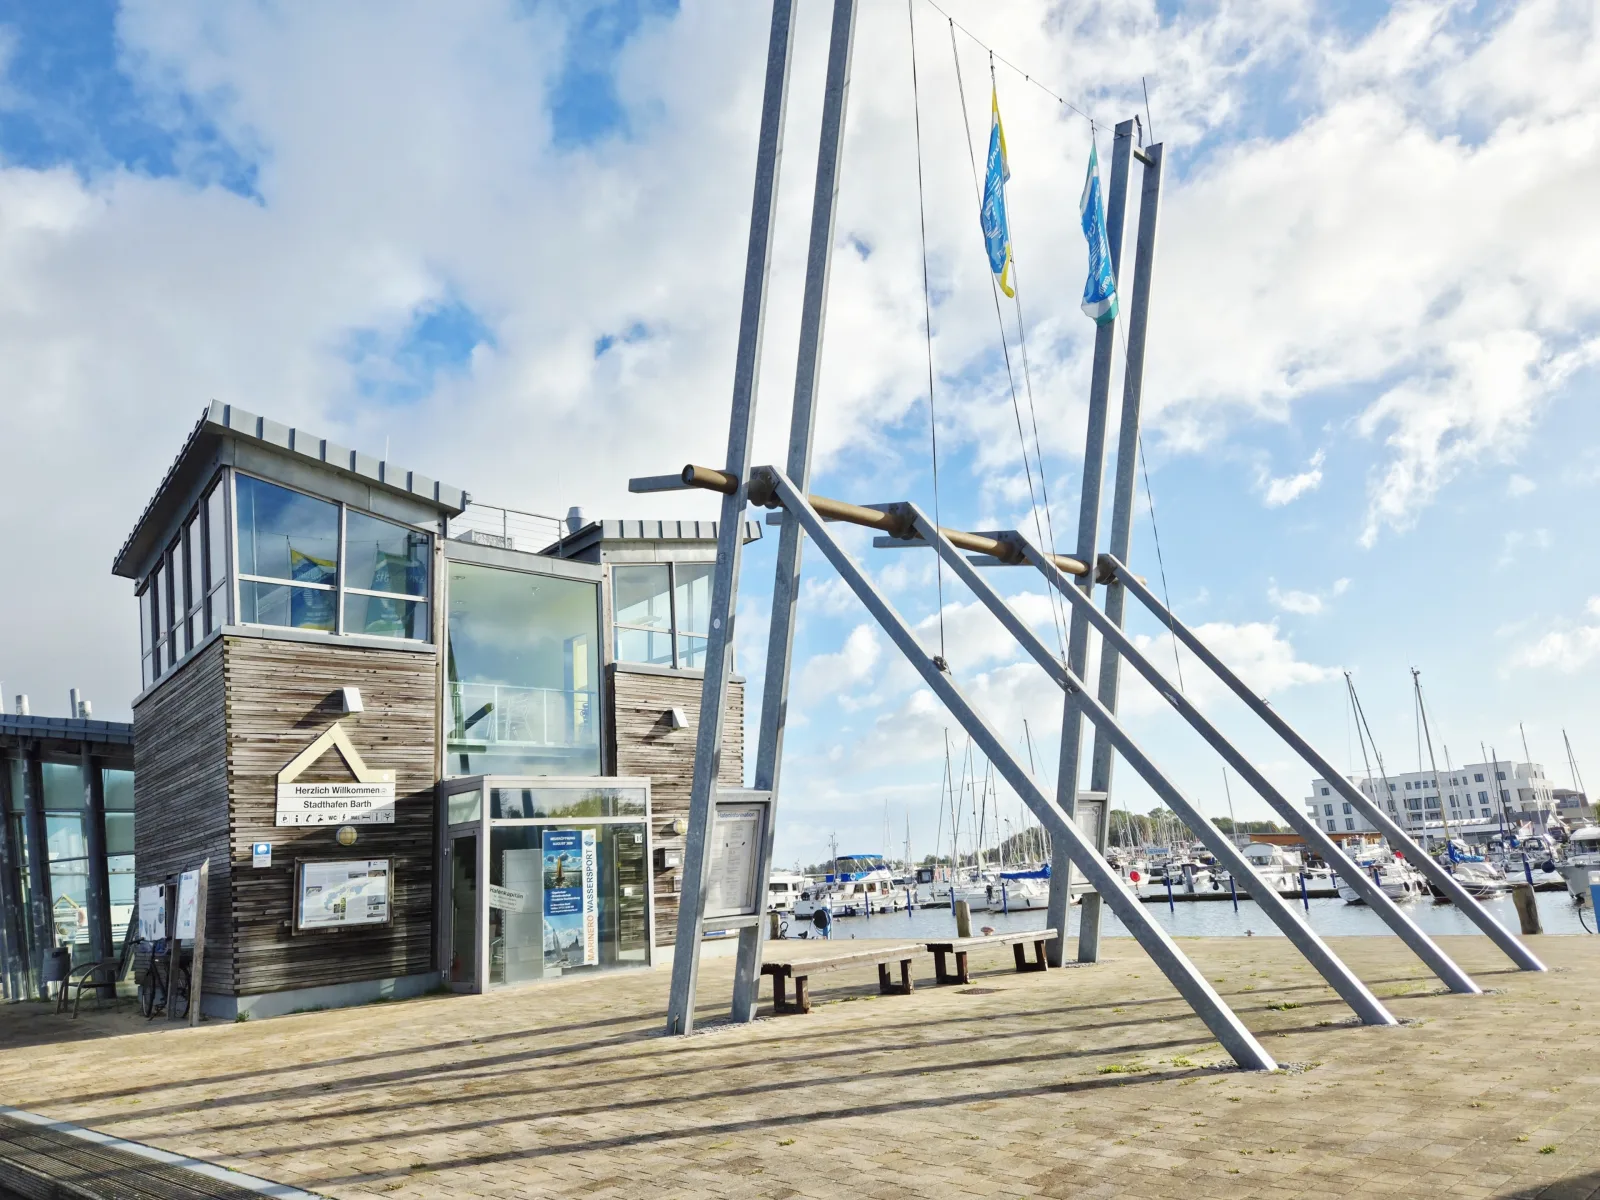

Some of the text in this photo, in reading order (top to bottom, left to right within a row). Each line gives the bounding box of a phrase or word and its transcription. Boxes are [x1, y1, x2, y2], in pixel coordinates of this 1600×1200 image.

[295, 786, 380, 795] Herzlich Willkommen
[303, 800, 372, 809] Stadthafen Barth
[587, 849, 596, 961] MARINERO WASSERSPORT
